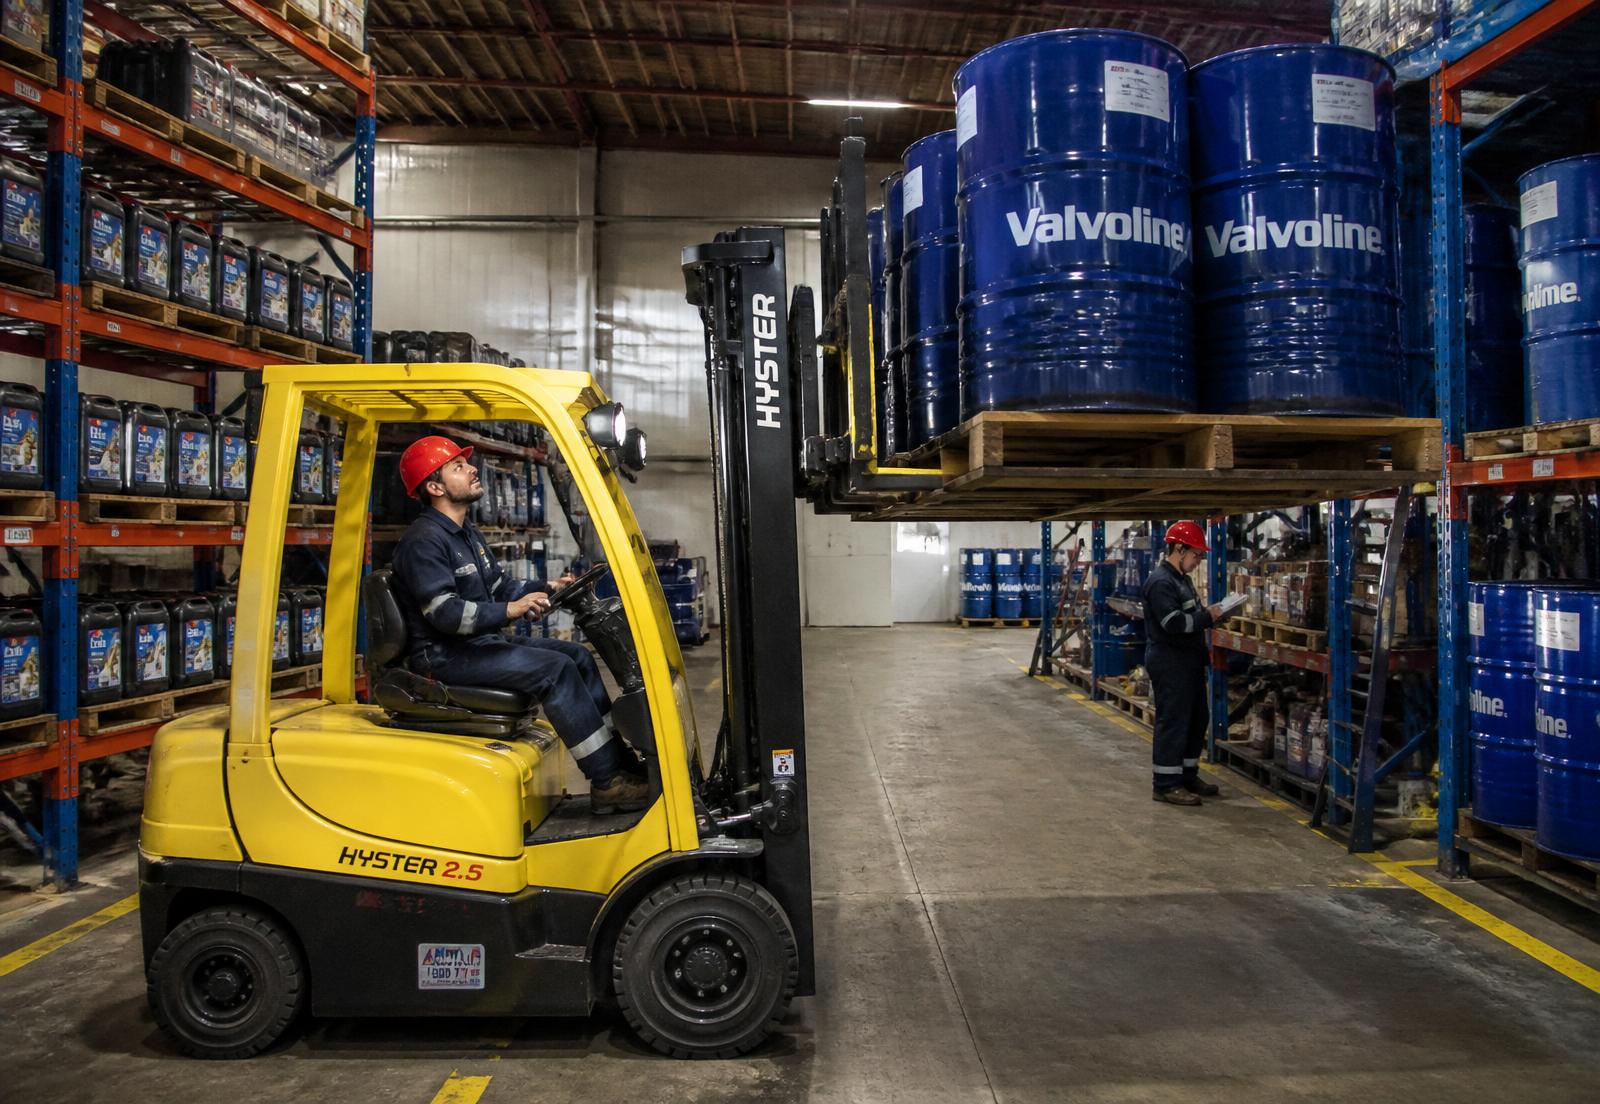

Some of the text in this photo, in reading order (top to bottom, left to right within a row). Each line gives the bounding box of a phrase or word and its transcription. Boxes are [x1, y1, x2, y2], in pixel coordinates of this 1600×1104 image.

[1006, 205, 1184, 253] Valvoline
[1205, 213, 1382, 258] Valvoline
[752, 293, 781, 429] HYSTER
[338, 846, 484, 881] HYSTER 2.5
